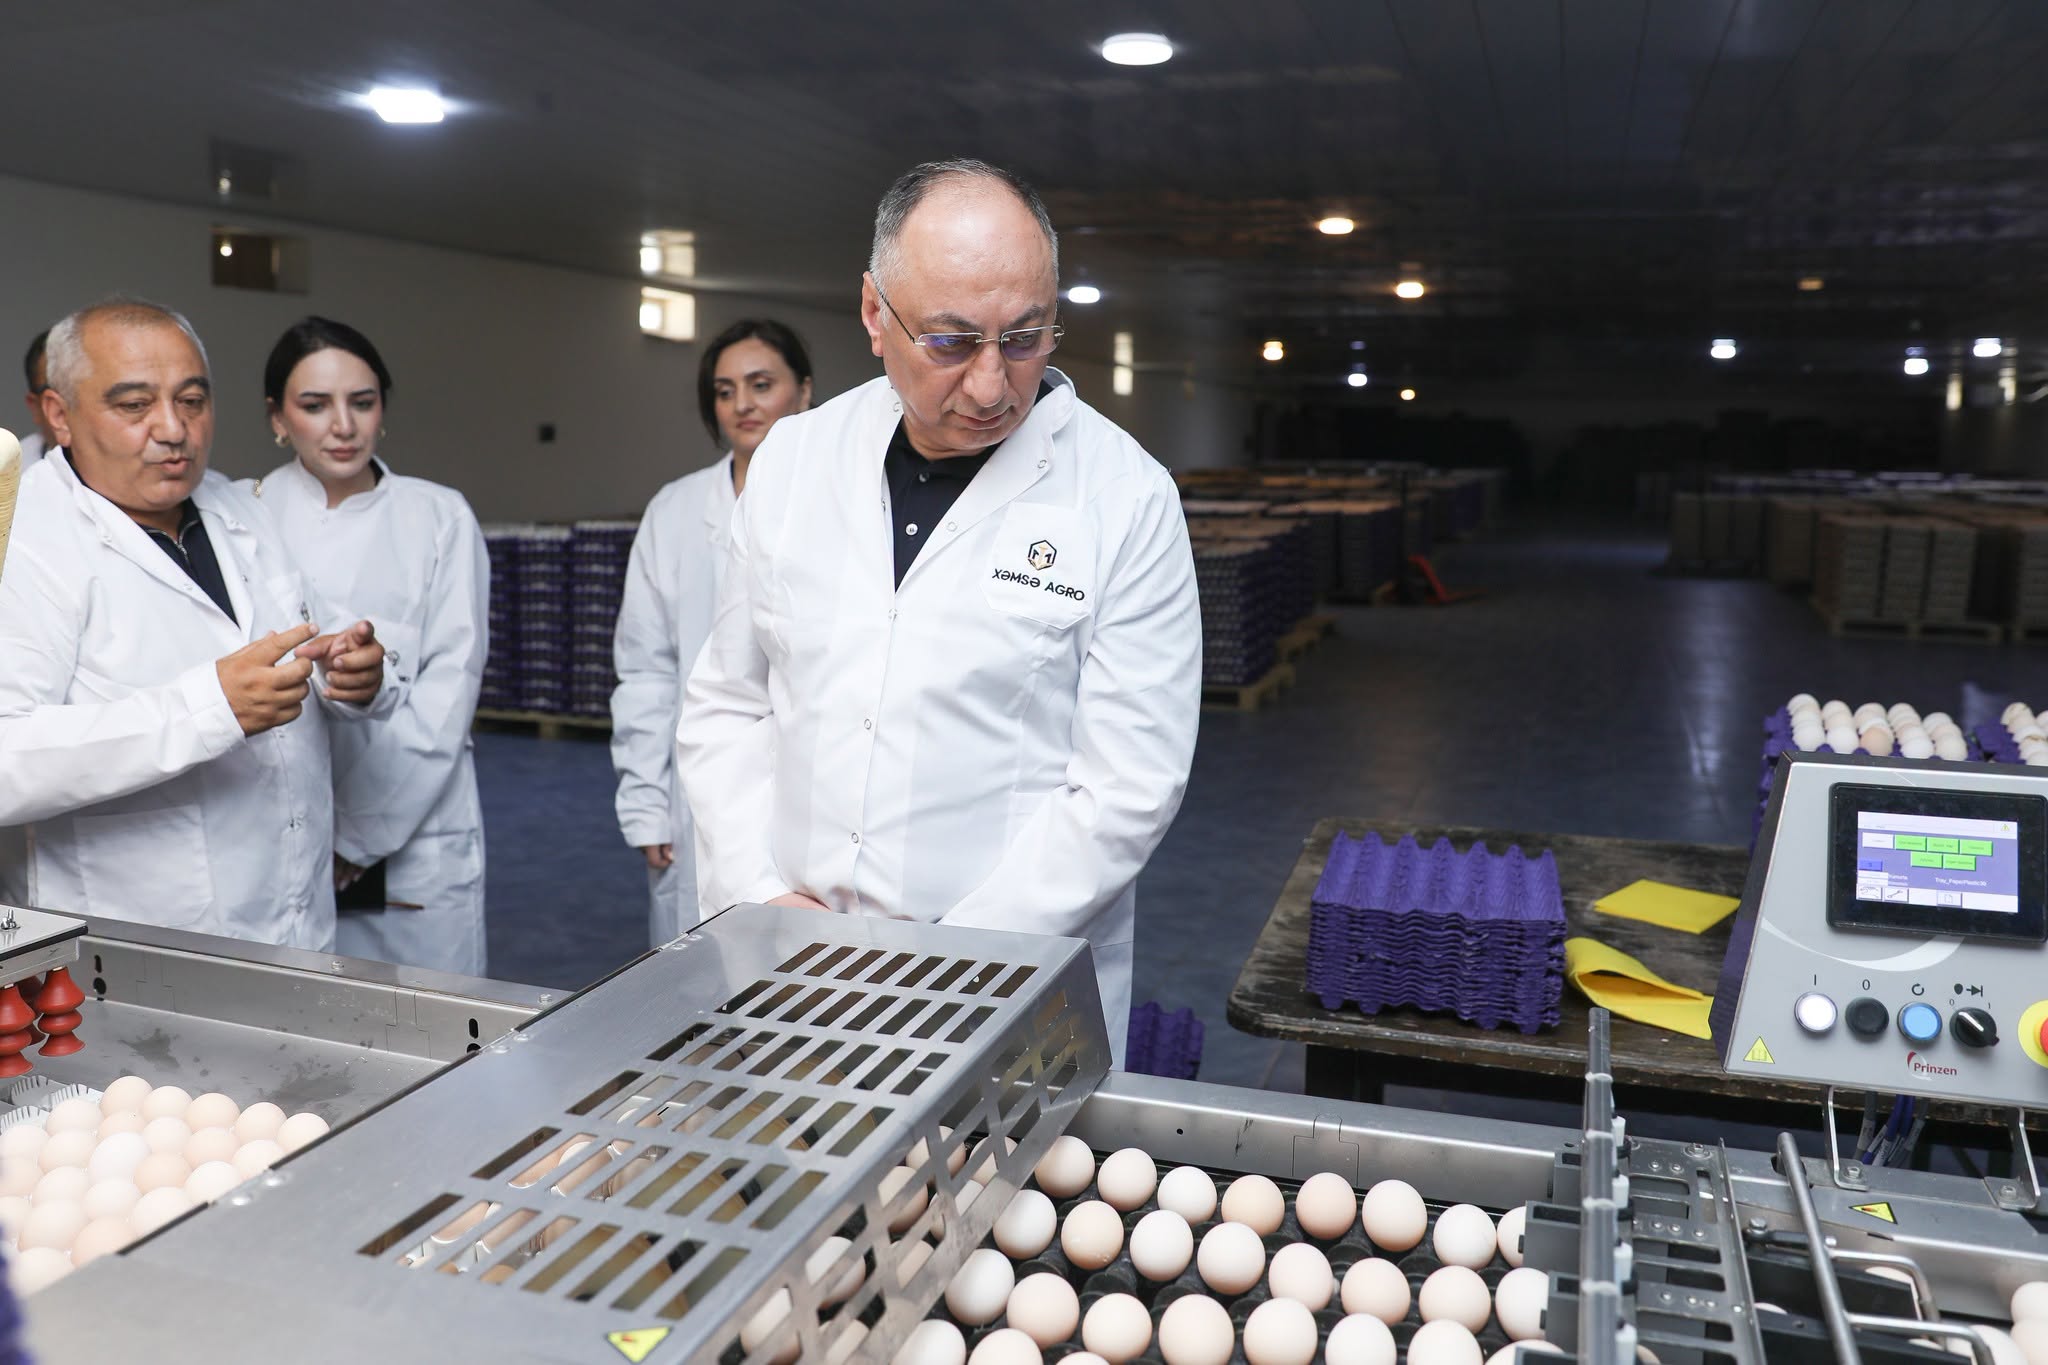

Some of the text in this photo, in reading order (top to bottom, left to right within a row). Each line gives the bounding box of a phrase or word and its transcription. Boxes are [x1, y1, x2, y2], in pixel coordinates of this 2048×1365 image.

[992, 568, 1085, 601] XƏMSƏ AGRO
[1913, 1062, 1958, 1076] Prinzen
